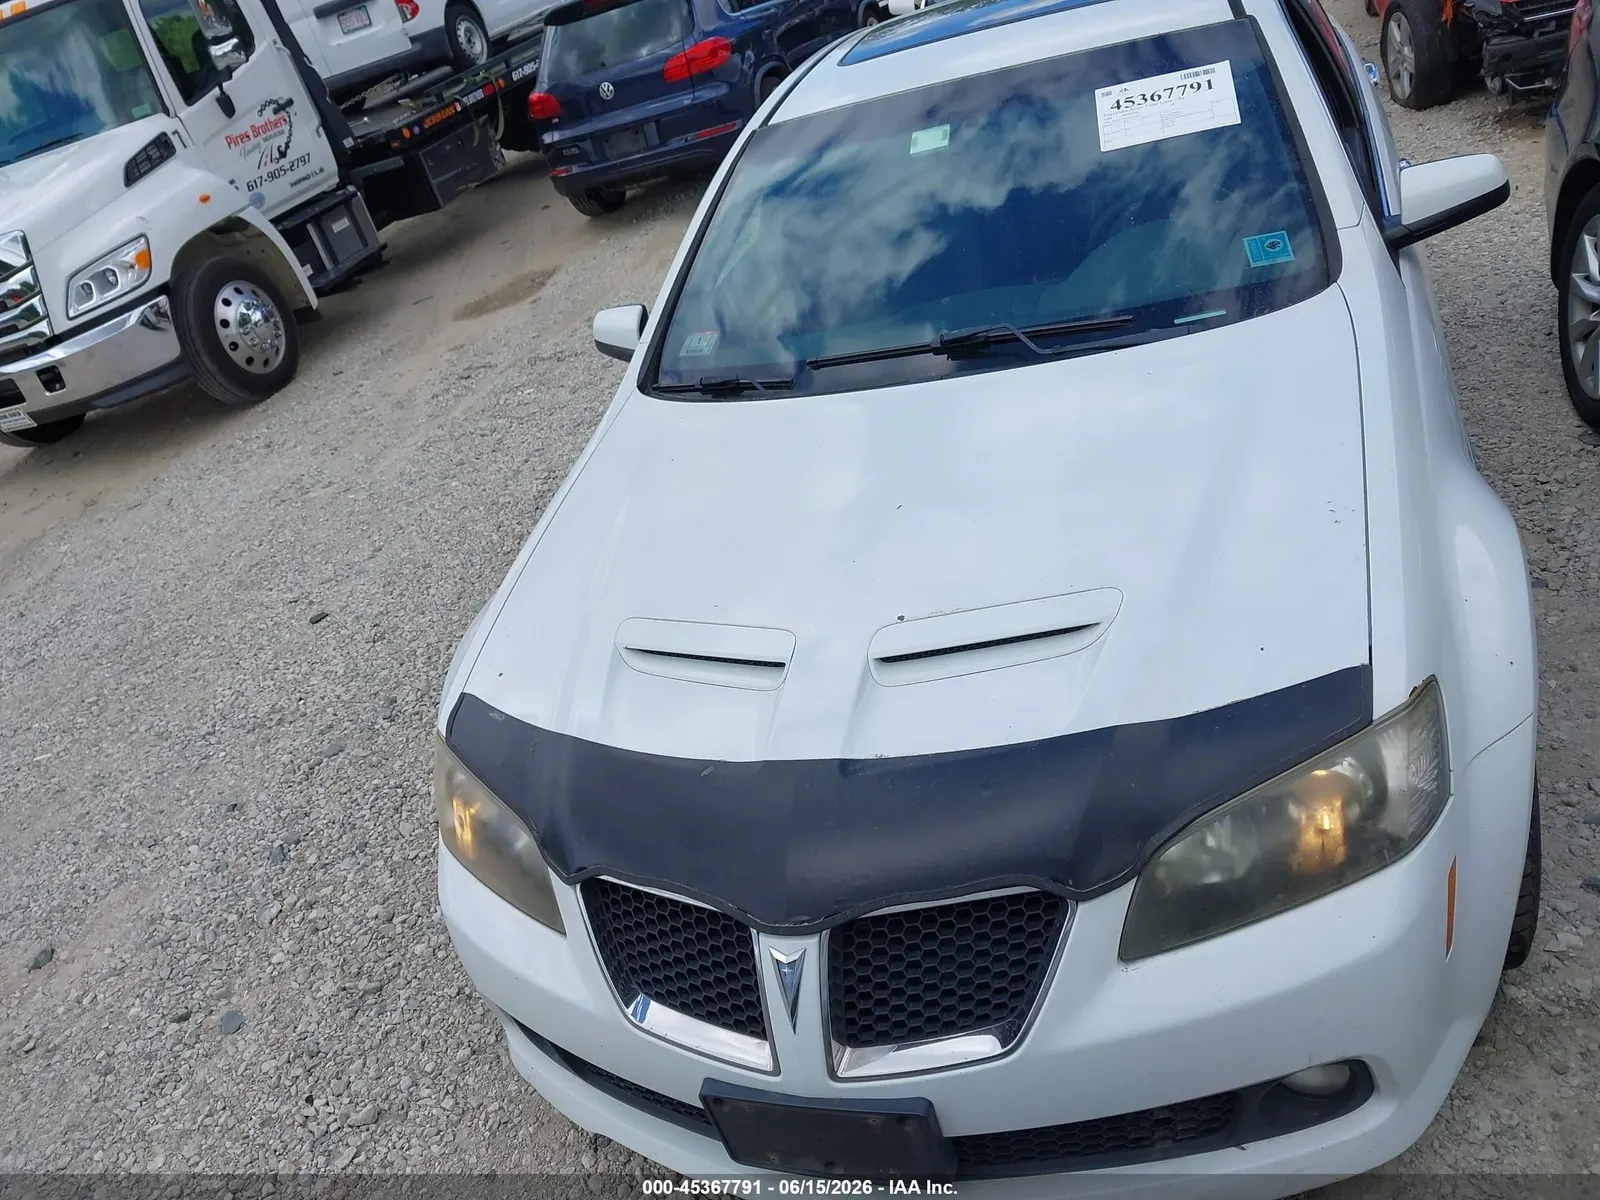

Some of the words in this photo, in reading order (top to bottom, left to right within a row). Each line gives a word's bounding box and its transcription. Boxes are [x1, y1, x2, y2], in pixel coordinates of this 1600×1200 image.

[1110, 78, 1216, 111] 45367791
[224, 130, 252, 150] Pires
[250, 114, 288, 138] Brothers
[246, 152, 312, 193] 617-905-2797
